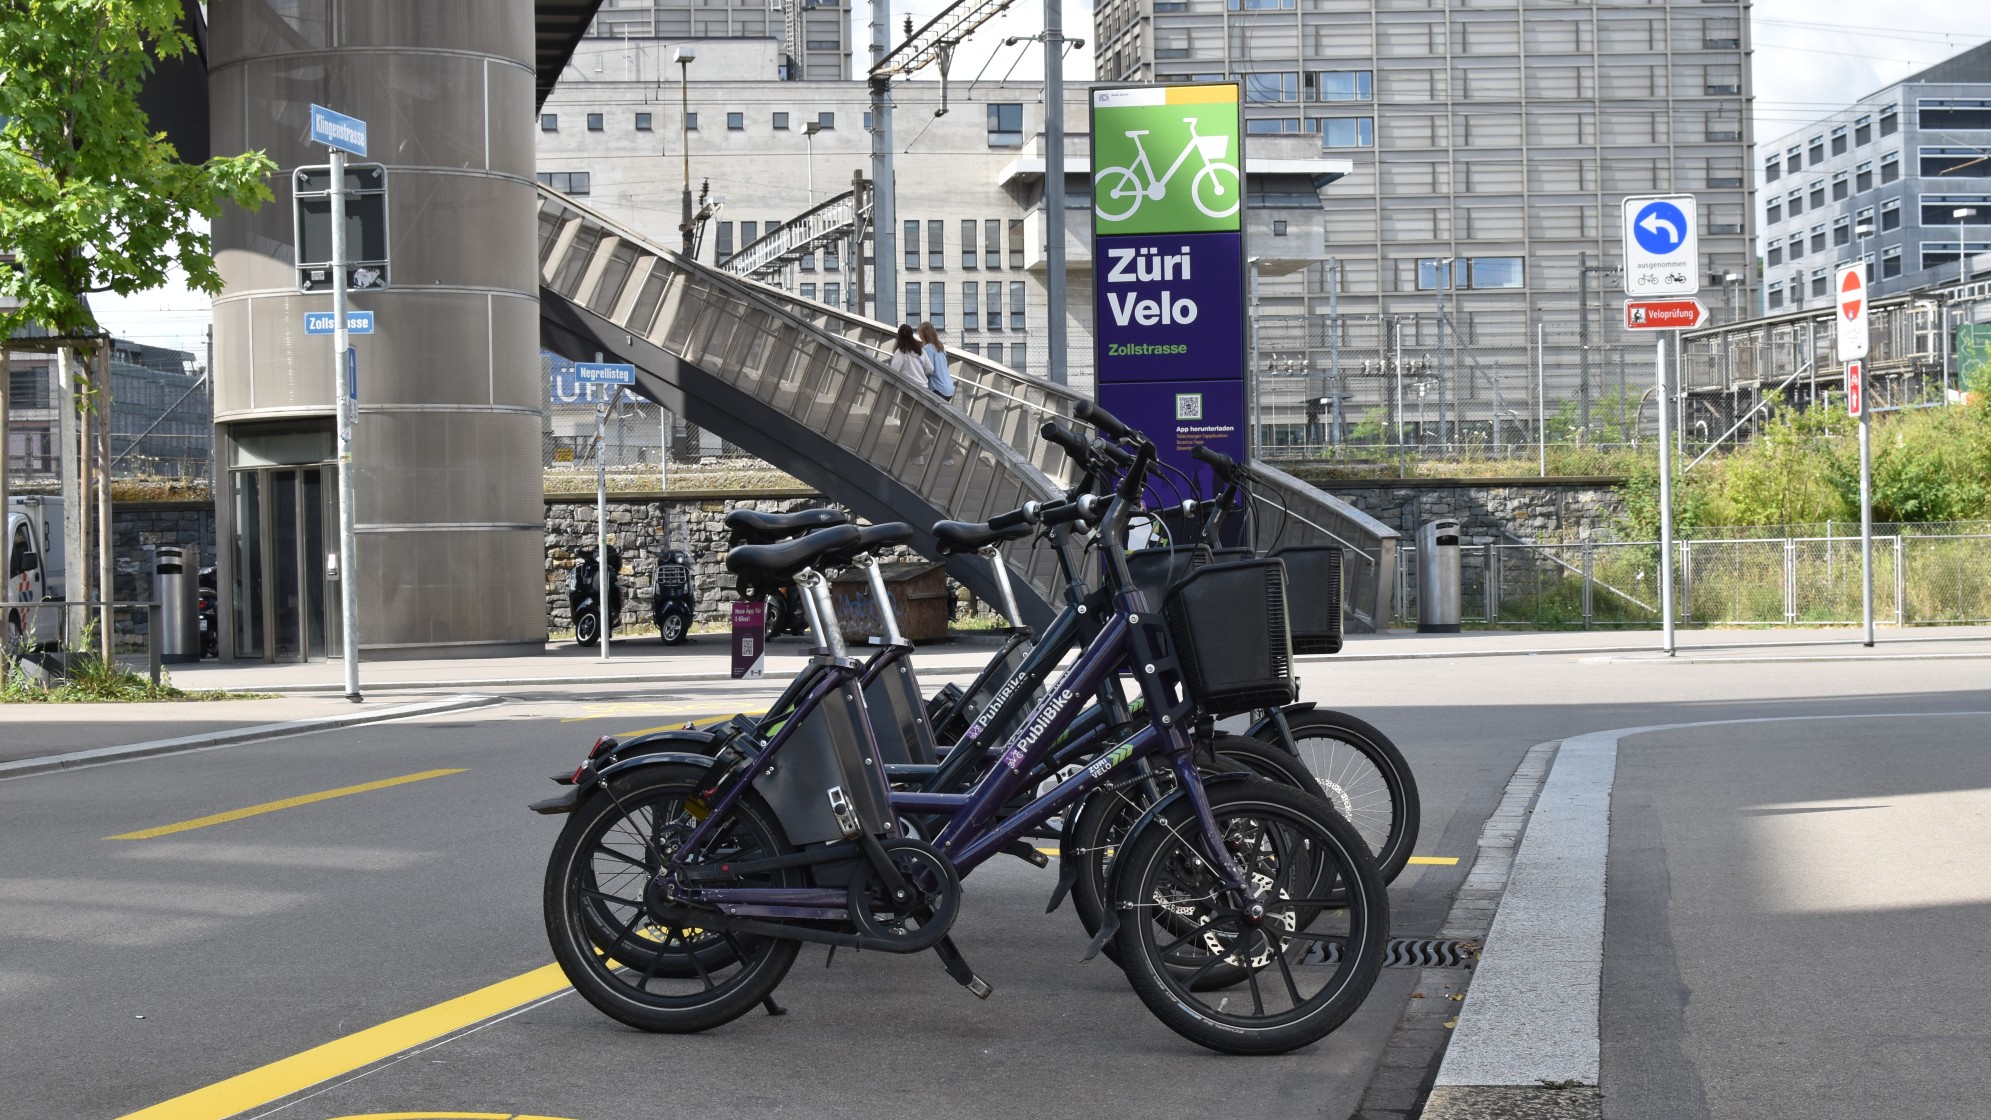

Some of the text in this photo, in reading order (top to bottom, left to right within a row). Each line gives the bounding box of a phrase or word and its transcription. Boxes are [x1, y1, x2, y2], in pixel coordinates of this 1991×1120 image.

[315, 113, 365, 147] Klingenstrasse
[1107, 246, 1191, 282] Züri
[1637, 261, 1687, 270] ausgenommen
[1107, 290, 1198, 326] Velo
[1648, 308, 1693, 320] Veloprüfung
[309, 317, 369, 330] Zollssse
[1108, 343, 1187, 356] Zollstrasse
[580, 367, 629, 382] Negrellisteg
[978, 672, 1027, 727] PubliBike
[1016, 689, 1073, 753] PubliBike
[1091, 763, 1112, 779] VELO
